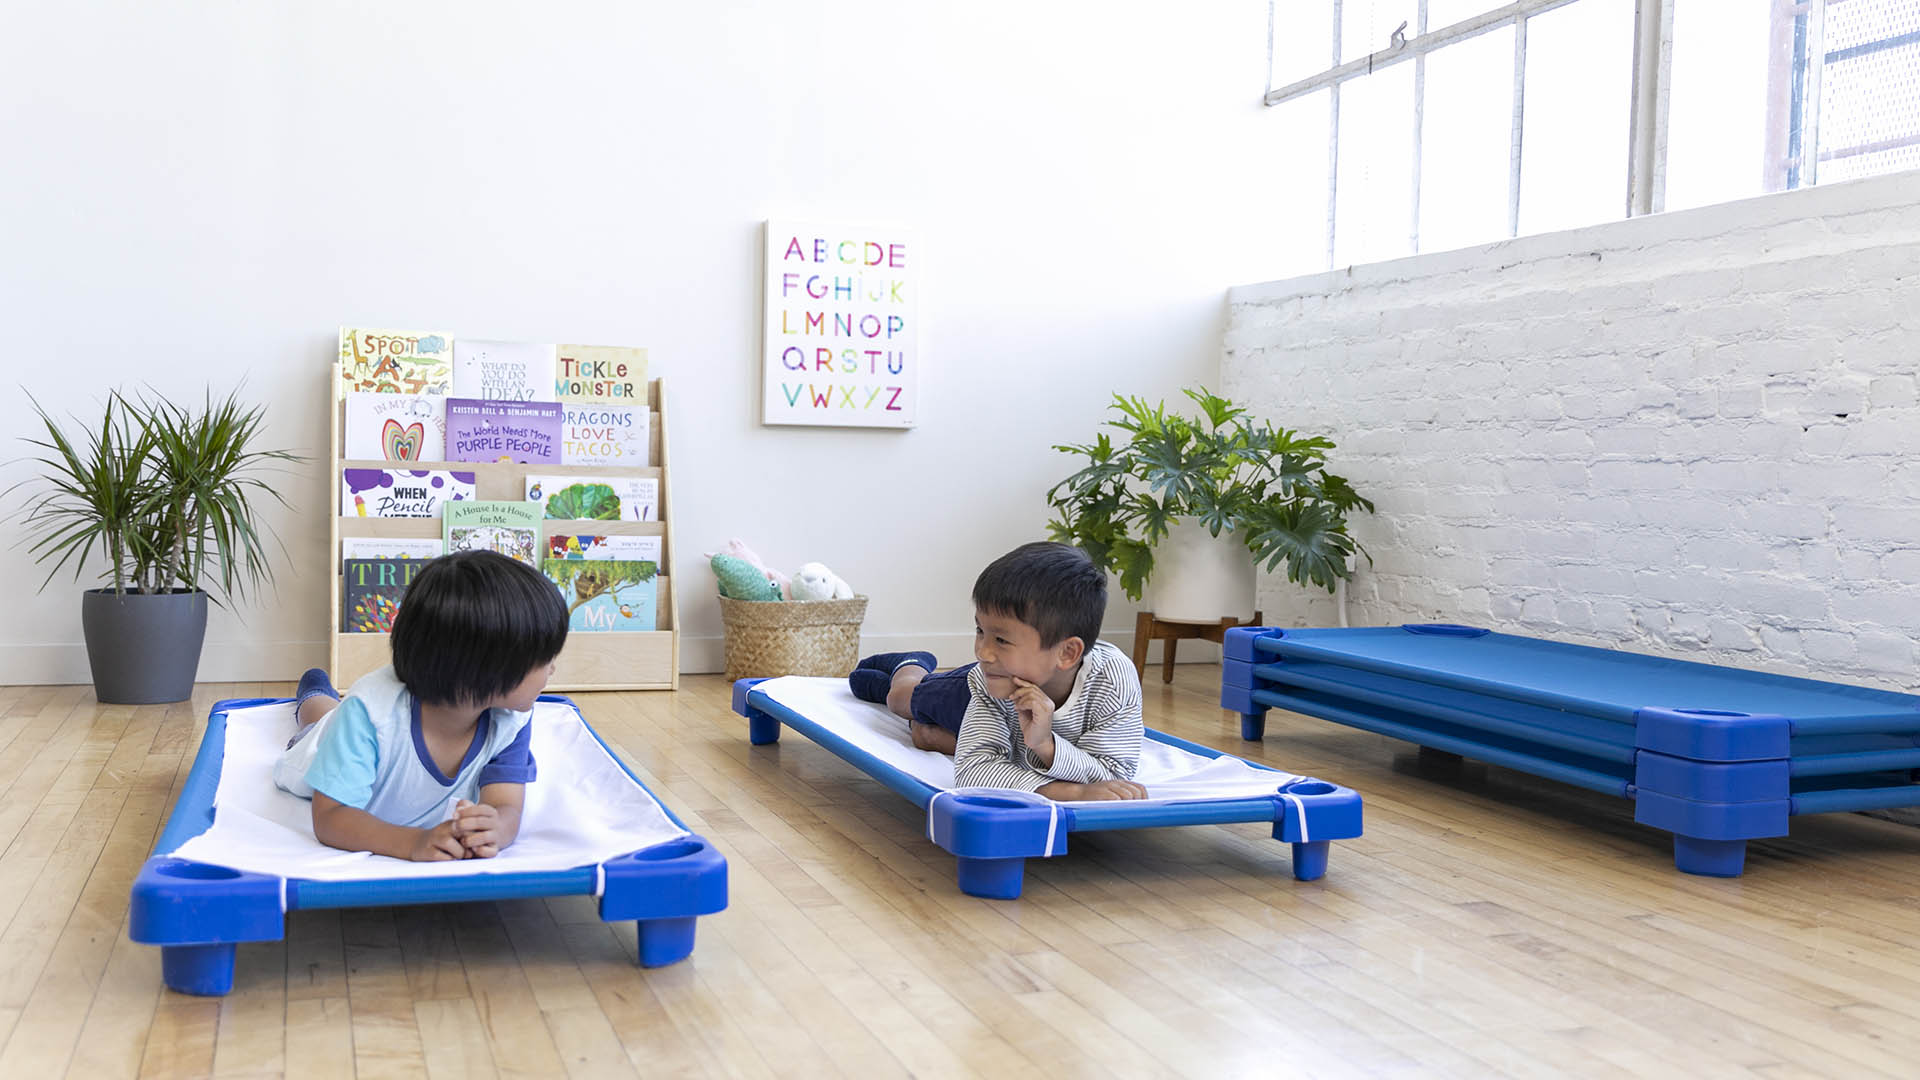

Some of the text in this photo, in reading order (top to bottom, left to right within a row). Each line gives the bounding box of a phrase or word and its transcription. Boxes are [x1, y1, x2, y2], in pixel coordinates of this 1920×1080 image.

[364, 335, 419, 355] SPOT
[481, 362, 526, 371] WHAT DO
[481, 370, 526, 380] YOU DO
[481, 379, 526, 388] WITH AN
[481, 387, 535, 402] IDEA?
[373, 400, 406, 415] IN MY
[452, 406, 479, 414] KRISTEN
[481, 407, 496, 415] BELL
[507, 408, 539, 416] BENJAMIN
[457, 430, 471, 439] The
[473, 426, 499, 436] World
[530, 429, 551, 442] More
[571, 427, 616, 441] LOVE
[456, 437, 552, 457] PURPLE PEOPLE
[563, 441, 623, 459] TACOS
[394, 487, 428, 499] WHEN
[376, 496, 436, 516] Pencil
[455, 511, 462, 519] A
[462, 505, 490, 516] House
[492, 504, 499, 513] Is
[507, 505, 533, 520] House
[493, 516, 507, 524] Me
[583, 606, 618, 632] My
